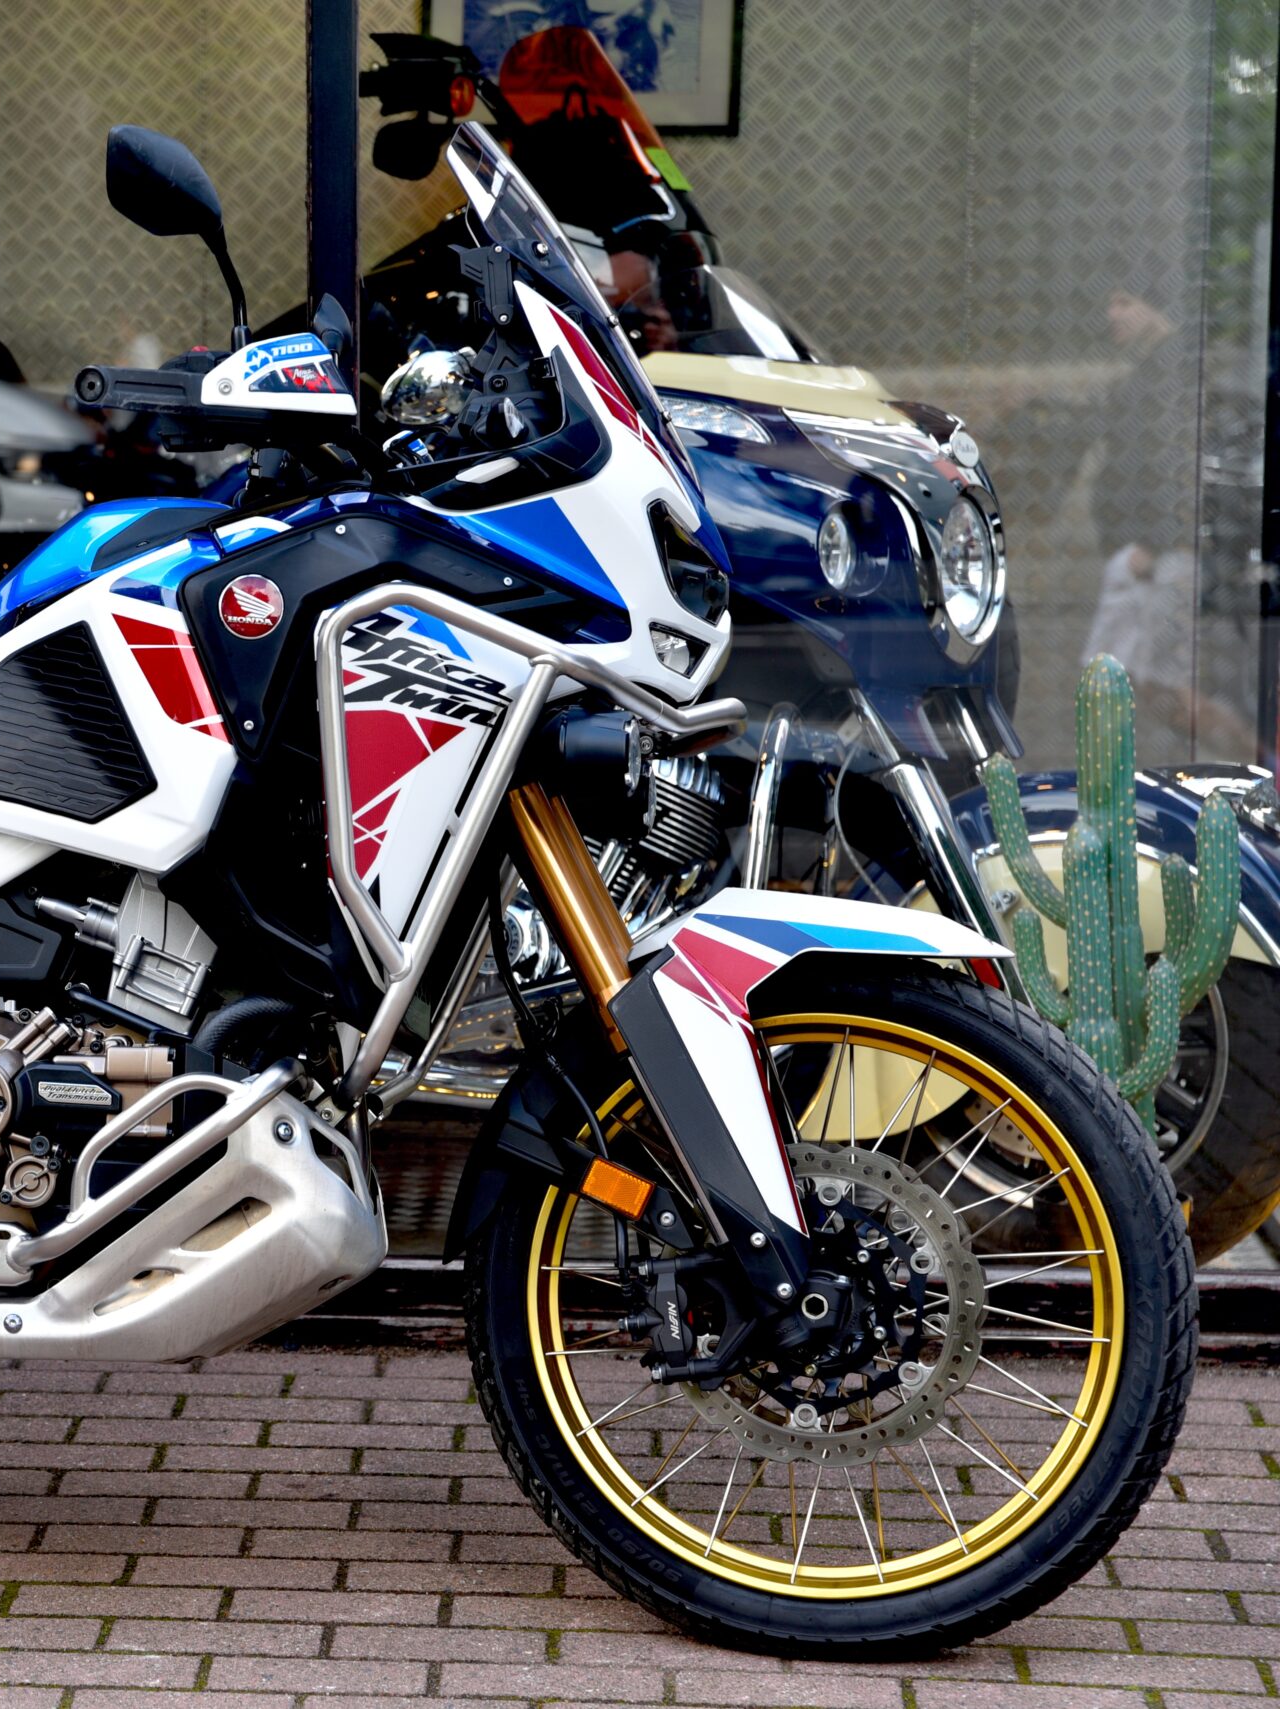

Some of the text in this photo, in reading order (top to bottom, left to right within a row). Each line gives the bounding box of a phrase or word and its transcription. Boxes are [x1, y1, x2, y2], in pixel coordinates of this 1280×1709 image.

[271, 343, 313, 357] 1100
[226, 615, 274, 626] HONDA
[47, 1091, 109, 1102] Transmission
[666, 1301, 681, 1340] NISSIN
[1045, 1440, 1116, 1545] STREET
